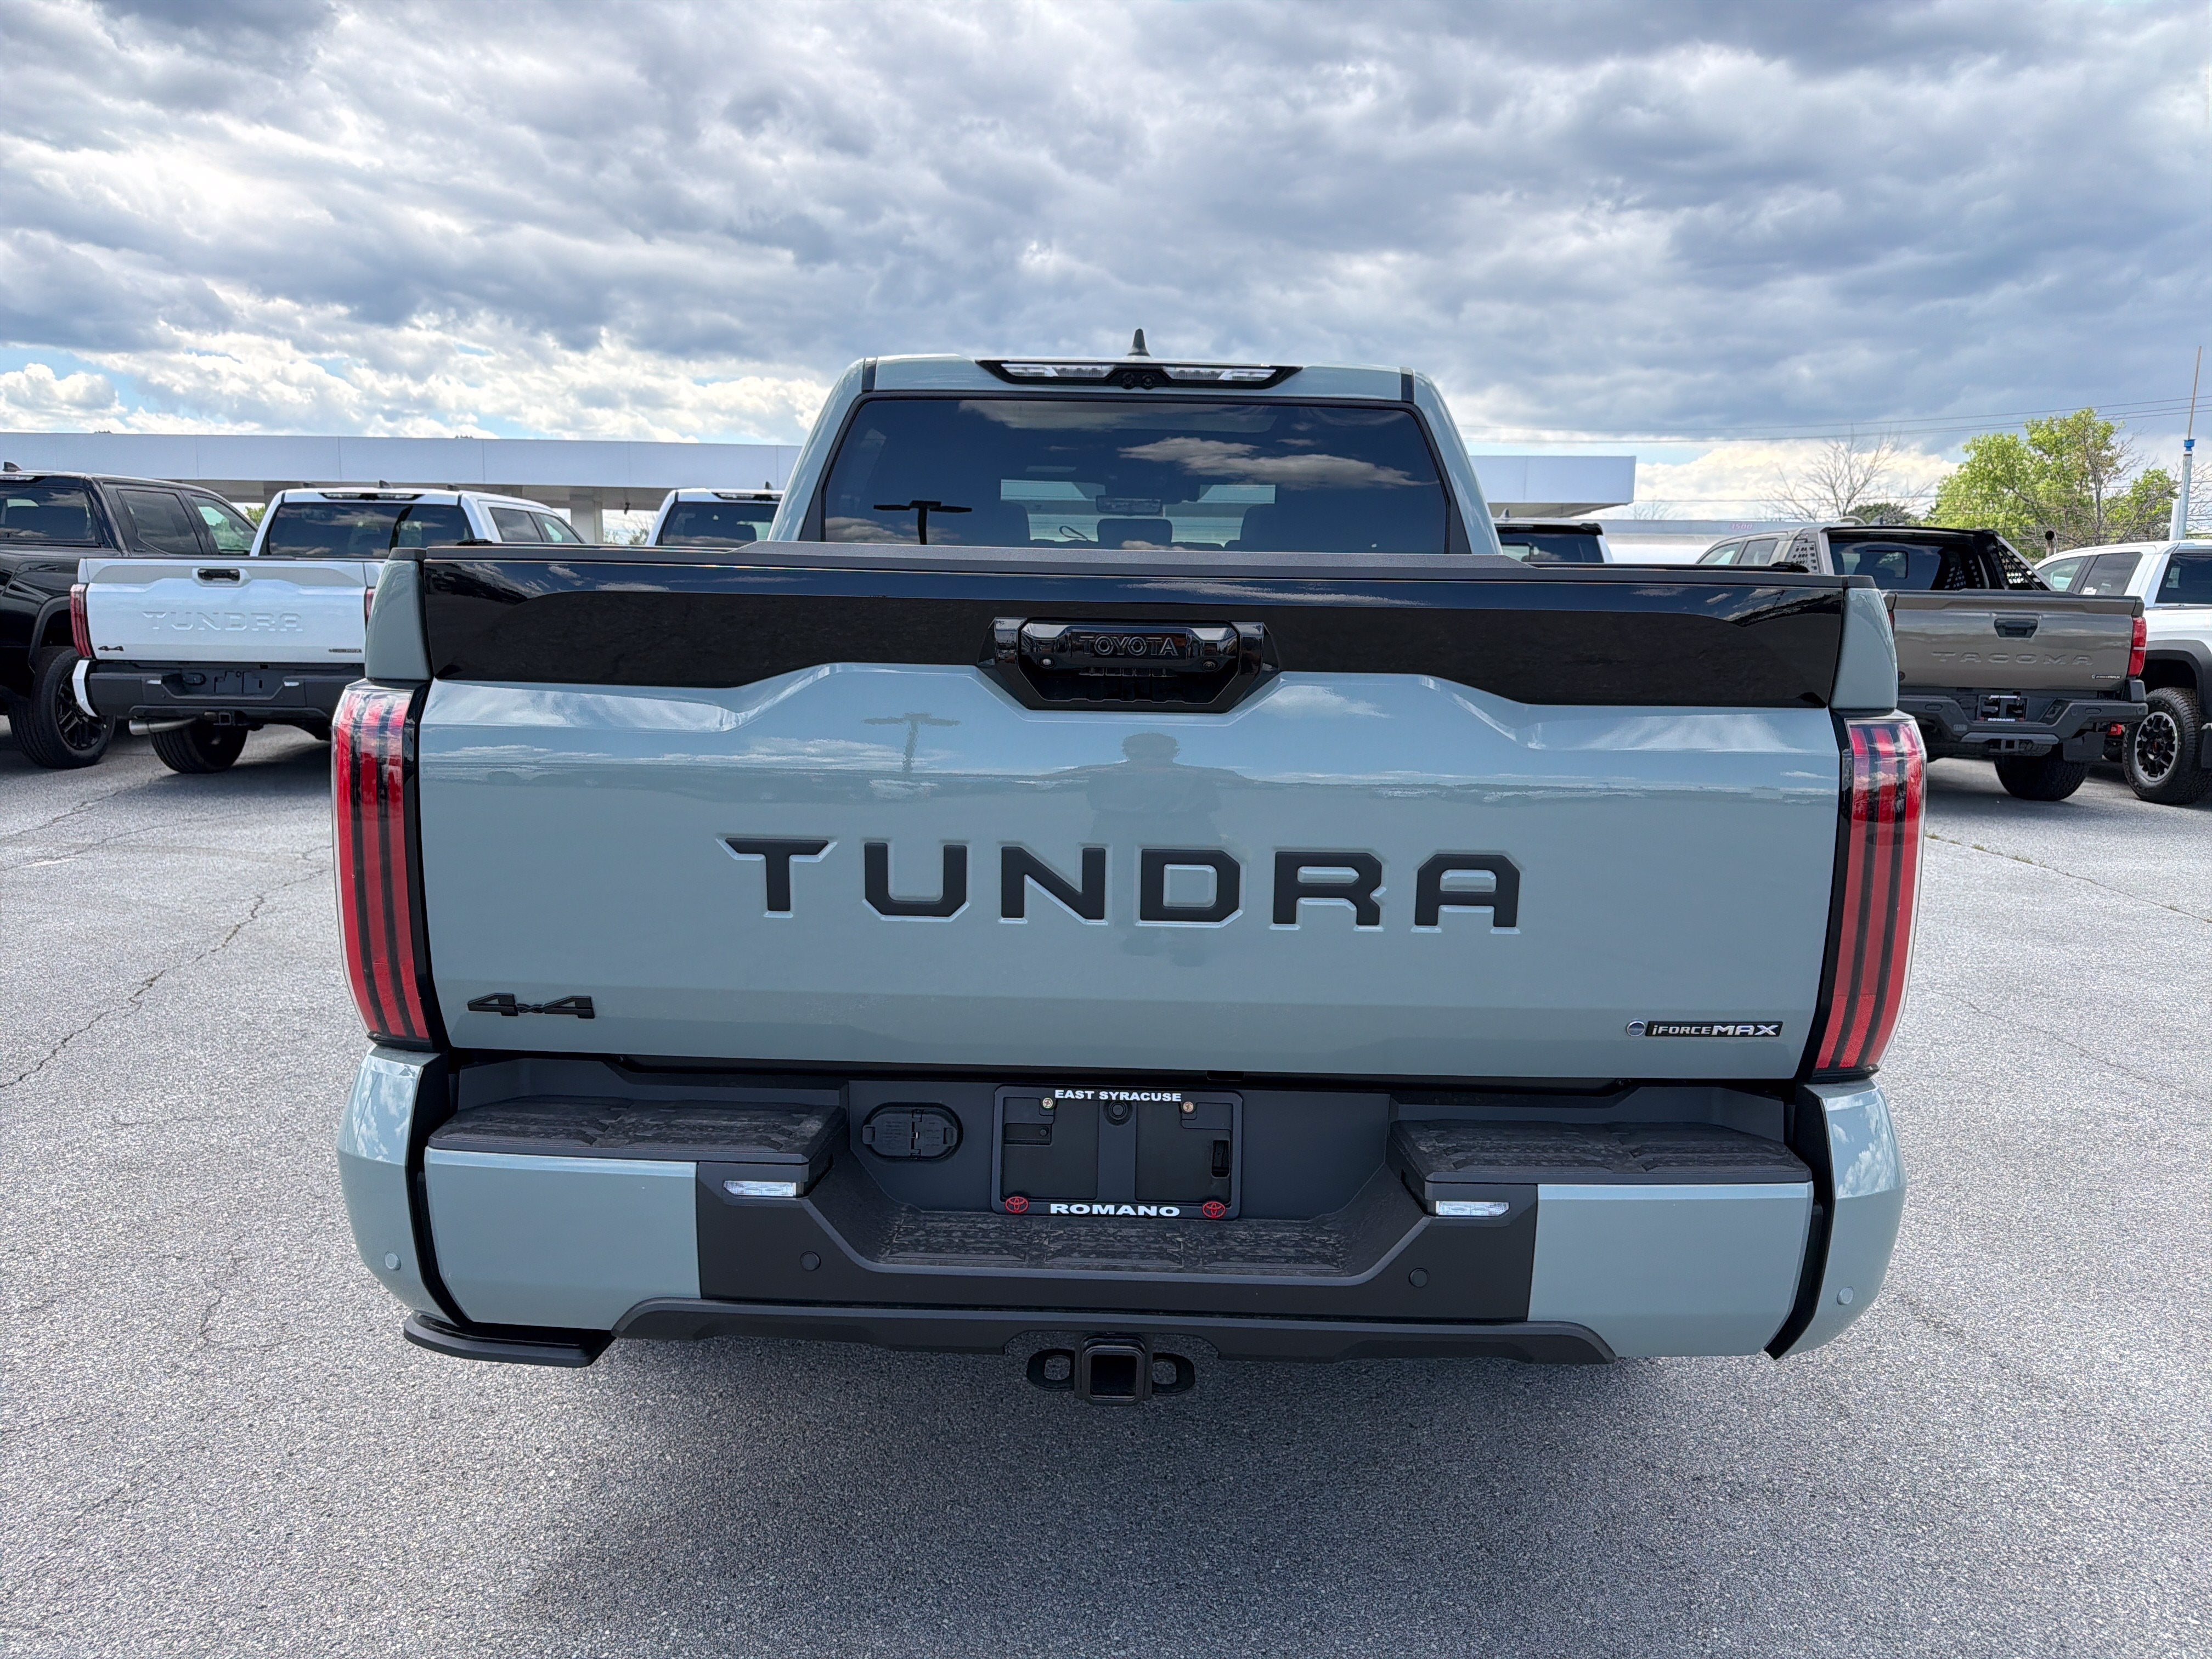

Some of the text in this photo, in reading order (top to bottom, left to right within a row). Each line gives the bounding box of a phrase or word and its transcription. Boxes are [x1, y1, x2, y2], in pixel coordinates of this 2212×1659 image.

[143, 611, 303, 632] TUNDRA
[1079, 635, 1179, 656] TOYOTA
[1931, 651, 2094, 666] TACOMA
[716, 835, 1521, 934] TUNDRA
[467, 992, 595, 1019] 4x4
[1054, 1090, 1182, 1102] EAST SYRACUSE
[1049, 1203, 1180, 1217] ROMANO
